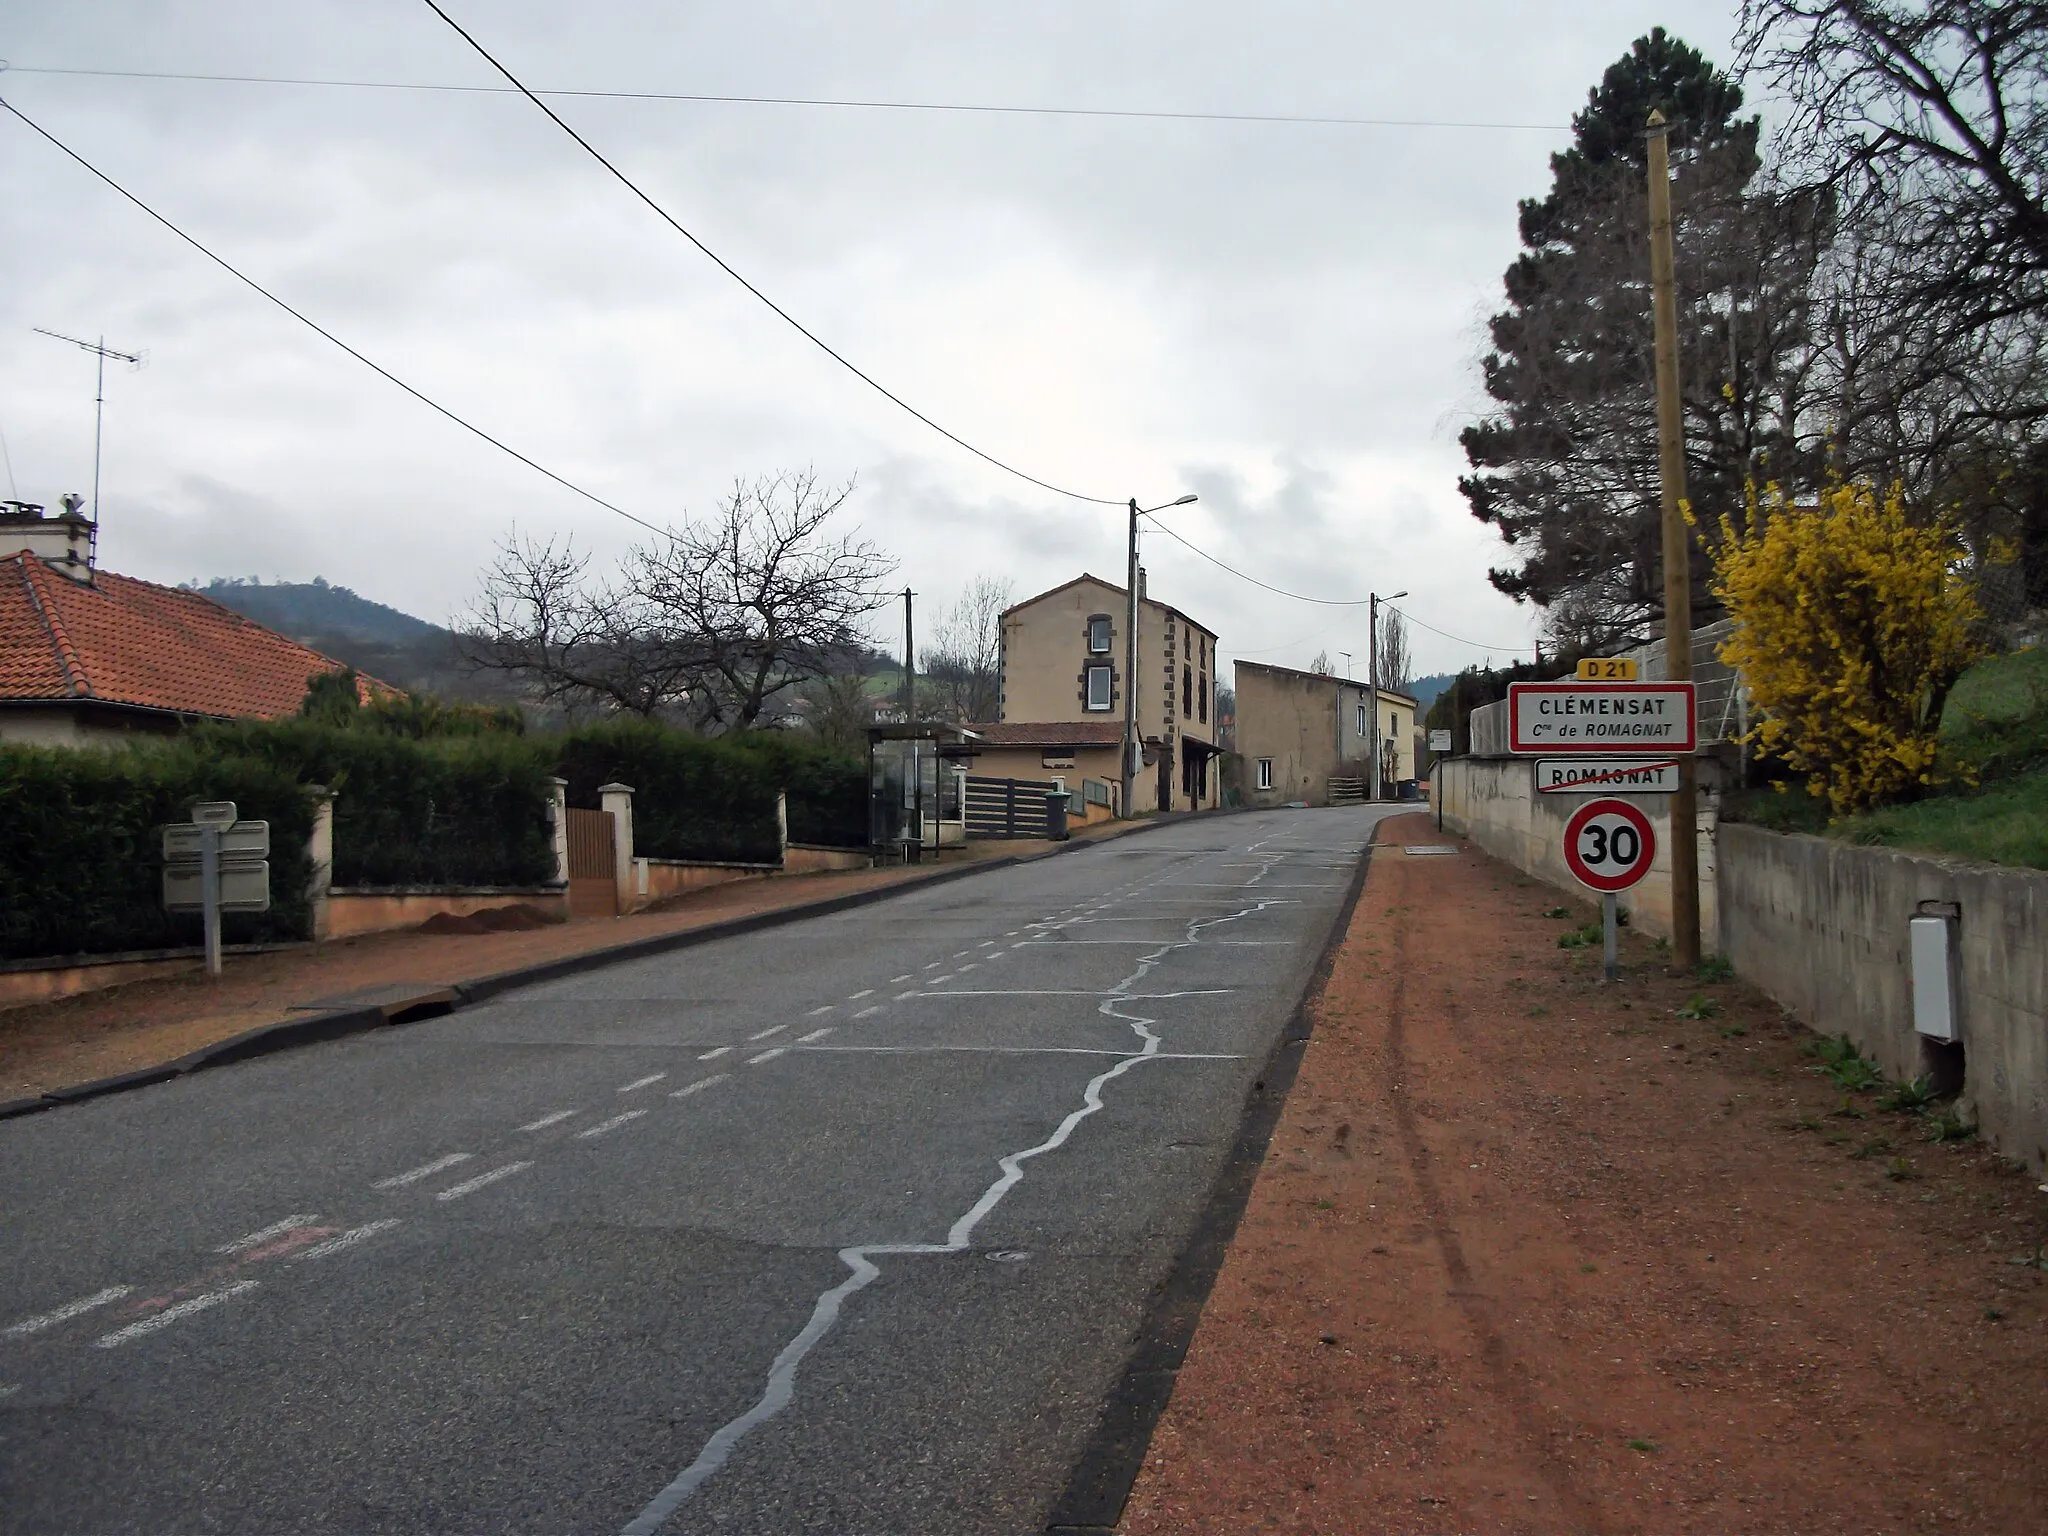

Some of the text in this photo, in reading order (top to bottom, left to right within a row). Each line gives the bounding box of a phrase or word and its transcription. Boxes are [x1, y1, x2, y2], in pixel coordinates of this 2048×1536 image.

[1588, 662, 1626, 677] D 21
[1539, 696, 1665, 715] CLÉMENSAT
[1559, 723, 1577, 737] de
[1585, 723, 1672, 737] ROMAGNAT
[1552, 769, 1665, 785] ROMAGNAT
[1581, 825, 1639, 865] 30
